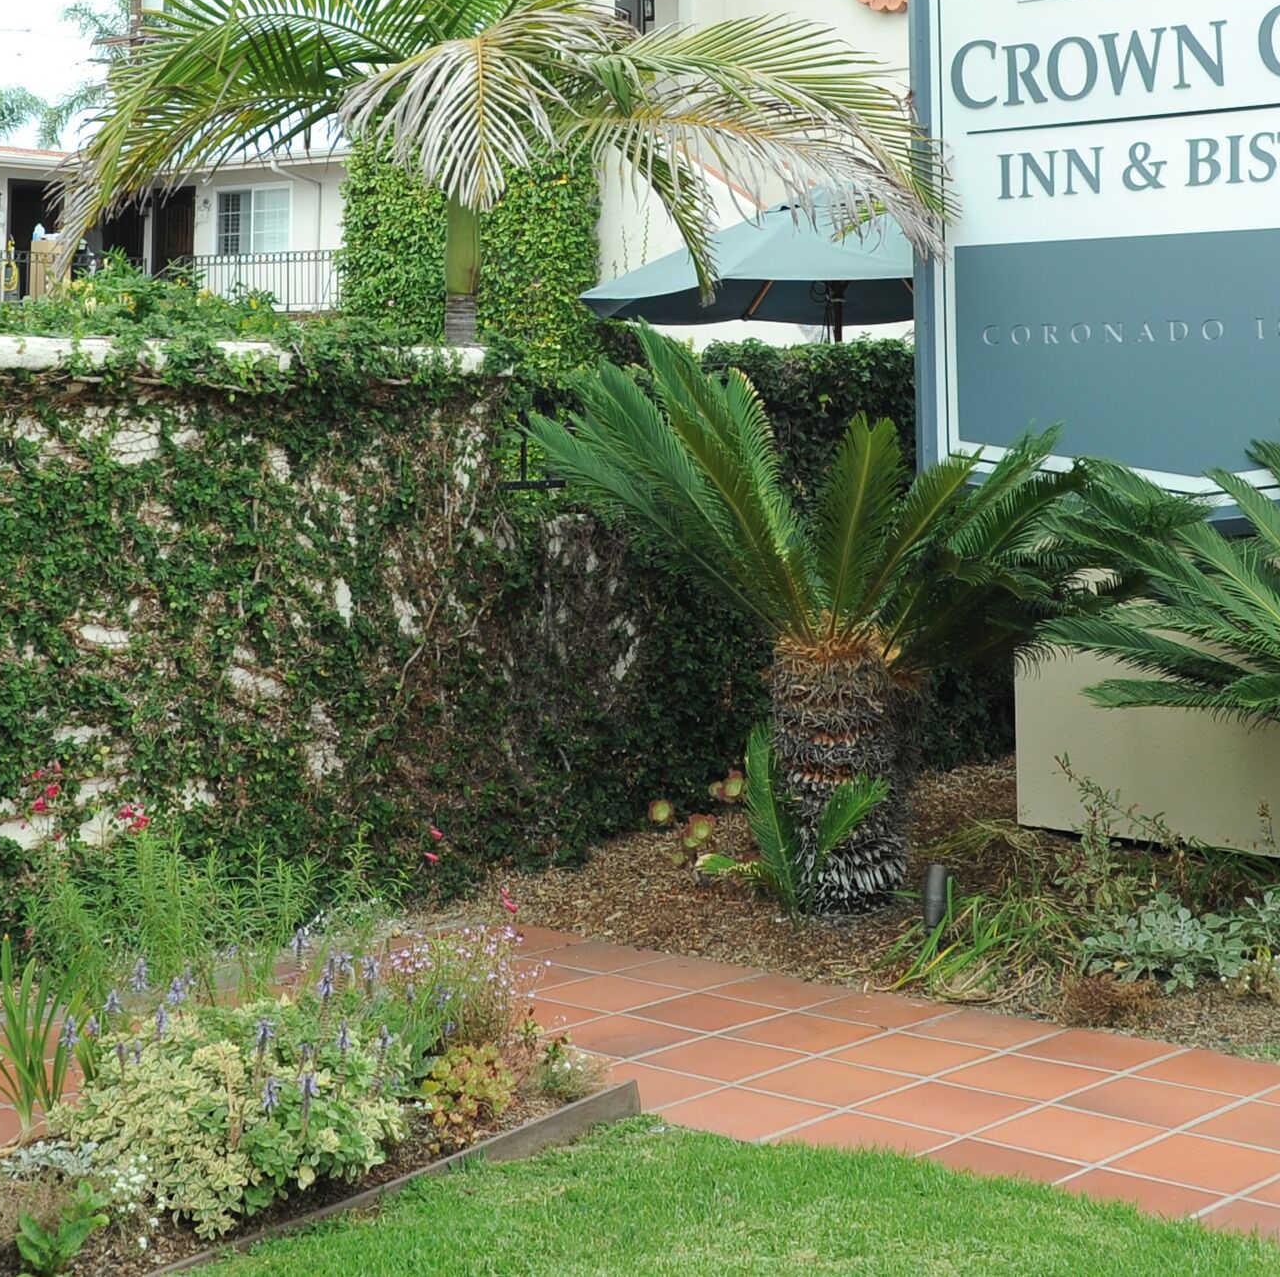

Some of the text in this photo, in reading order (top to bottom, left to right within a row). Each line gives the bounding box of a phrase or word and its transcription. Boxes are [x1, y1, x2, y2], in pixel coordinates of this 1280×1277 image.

[950, 20, 1228, 111] CROWN
[997, 146, 1105, 201] INN
[1122, 141, 1168, 192] &
[982, 319, 1225, 348] CORONADO
